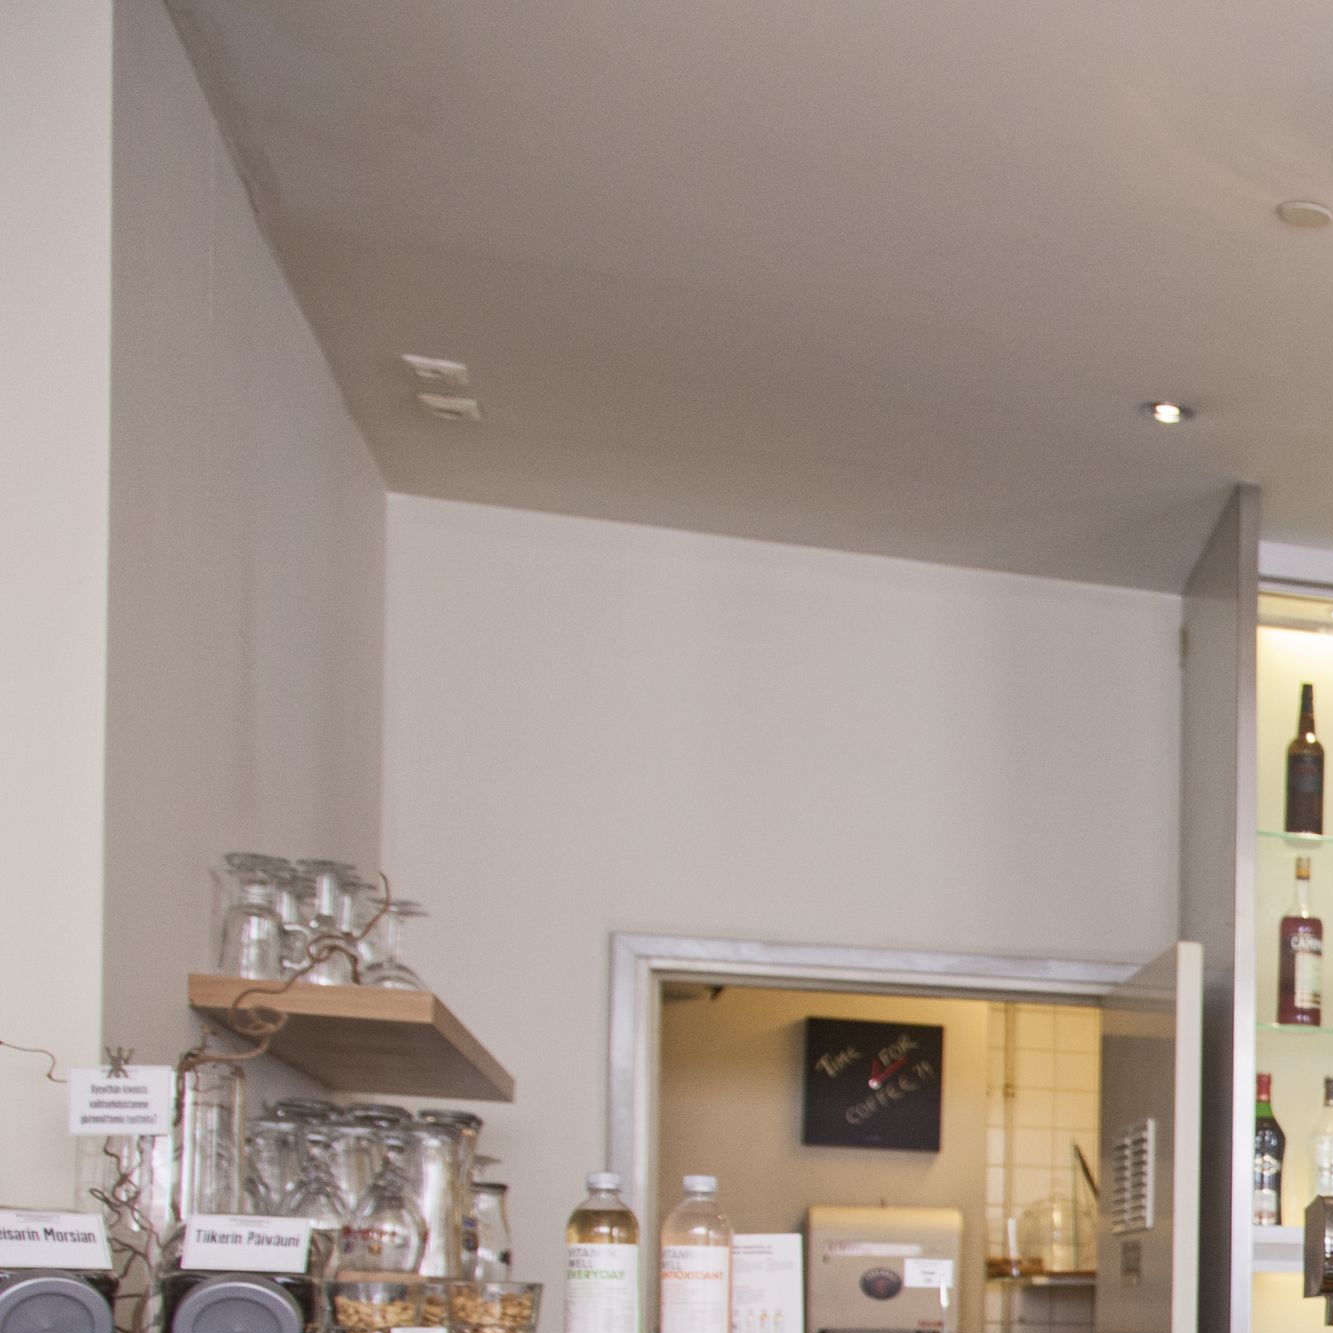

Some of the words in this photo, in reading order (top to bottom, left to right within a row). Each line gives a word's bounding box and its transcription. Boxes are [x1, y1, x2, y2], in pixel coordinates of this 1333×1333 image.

[43, 1227, 97, 1244] Morsian
[195, 1229, 243, 1245] Tiikerin
[247, 1231, 300, 1248] Päiväuni
[566, 1270, 625, 1280] EVERYDAY
